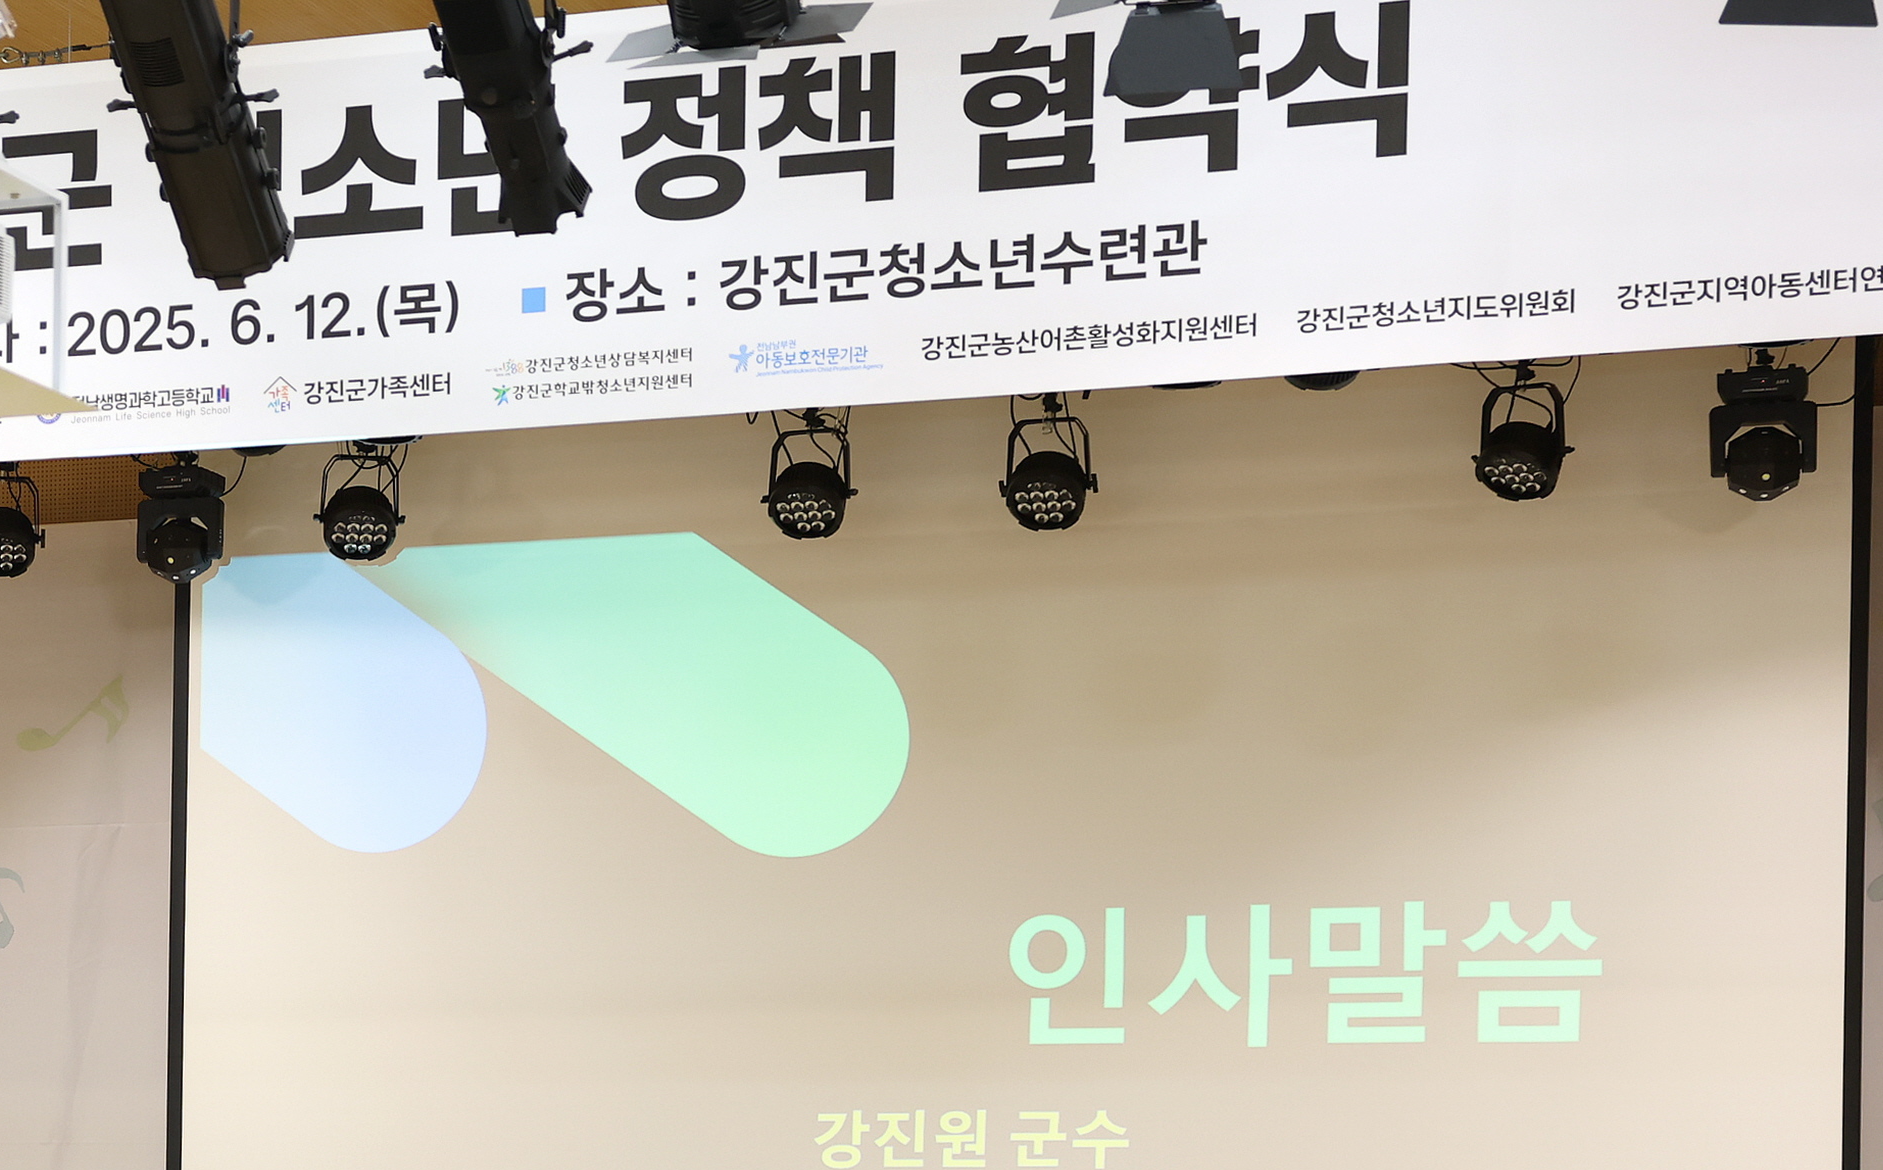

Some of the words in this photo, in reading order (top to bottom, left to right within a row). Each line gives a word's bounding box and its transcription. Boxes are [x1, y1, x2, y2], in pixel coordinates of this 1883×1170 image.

[621, 50, 897, 220] 정책
[565, 268, 665, 323] 장소
[719, 218, 1208, 312] 강진군청소년수련관
[67, 303, 209, 357] 2025.
[229, 299, 275, 345] 6.
[295, 280, 459, 341] 12.(목)
[1296, 288, 1577, 334] 강진군청소년지도위원회
[756, 345, 869, 369] 아동보호전문기관
[921, 312, 1258, 361] 강진군농산어촌활성화지원센터
[525, 347, 694, 375] 강진군청소년상담복지센터
[303, 372, 451, 405] 강진군가족센터
[512, 374, 694, 401] 강진군학교밖청소년지원센터
[71, 413, 111, 424] Jeonnam
[115, 411, 132, 421] Life
[136, 409, 172, 420] Science
[176, 407, 196, 419] High
[200, 406, 231, 416] School
[1007, 900, 1604, 1048] 인사말씀
[813, 1108, 989, 1170] 강진원
[1009, 1109, 1131, 1170] 군수
